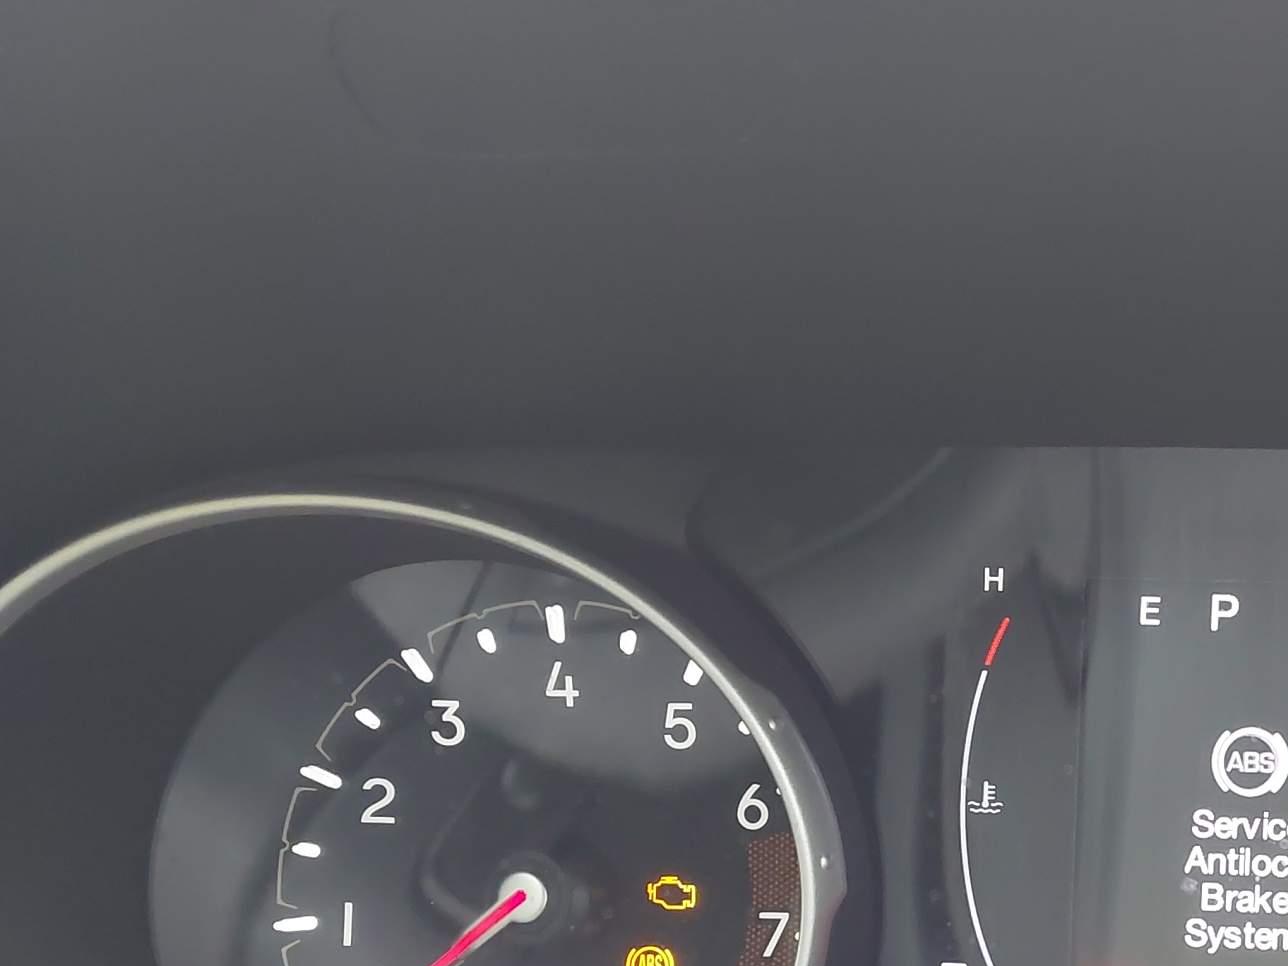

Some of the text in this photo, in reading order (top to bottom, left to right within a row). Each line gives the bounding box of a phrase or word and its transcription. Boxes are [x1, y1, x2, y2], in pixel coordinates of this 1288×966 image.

[984, 567, 1004, 592] H
[1139, 593, 1240, 632] E P
[545, 661, 580, 708] 4
[431, 699, 466, 746] 3
[663, 702, 697, 750] 5
[1226, 750, 1276, 773] ABS
[360, 777, 396, 824] 2
[736, 783, 769, 831] 6
[342, 901, 353, 947] 1
[758, 911, 790, 958] 7
